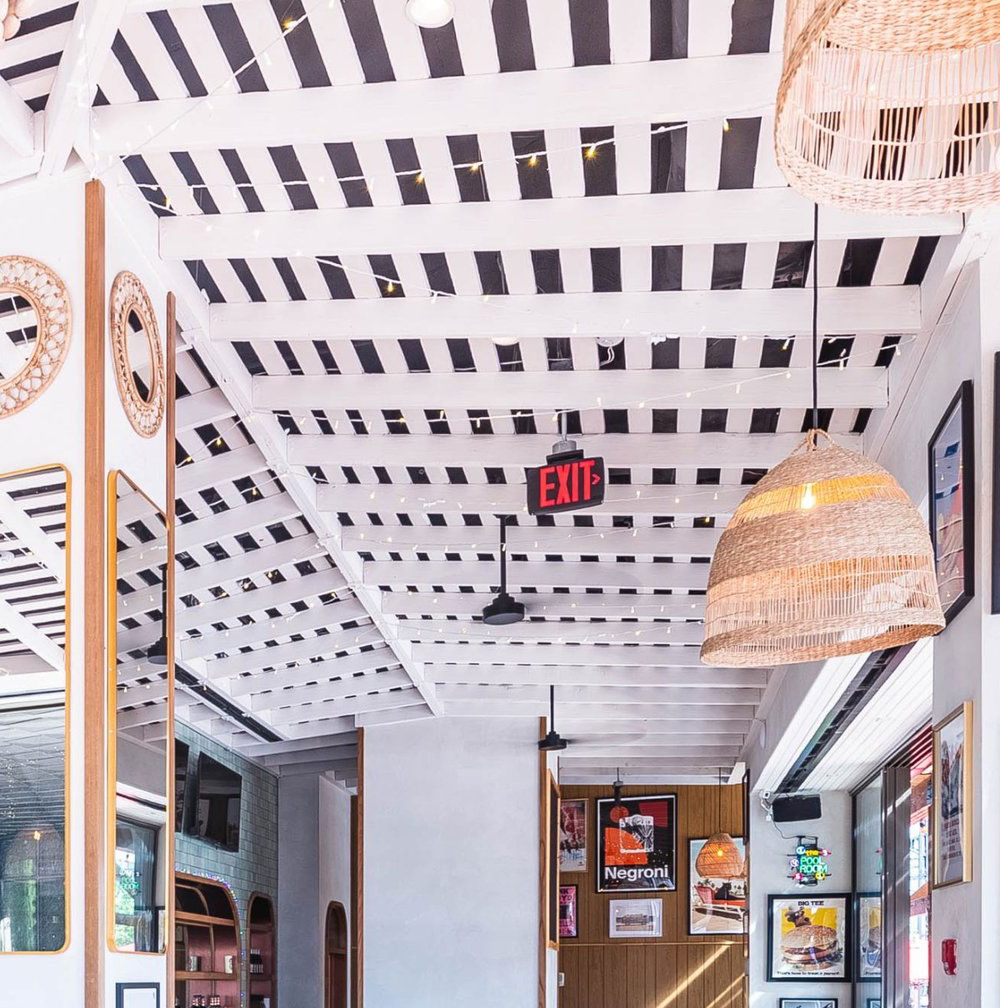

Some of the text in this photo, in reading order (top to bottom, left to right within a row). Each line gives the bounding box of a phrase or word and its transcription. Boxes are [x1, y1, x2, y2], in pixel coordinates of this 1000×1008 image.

[539, 459, 595, 508] EXIT
[800, 856, 826, 865] POOL
[604, 864, 669, 880] Negroni
[799, 864, 828, 873] ROOM
